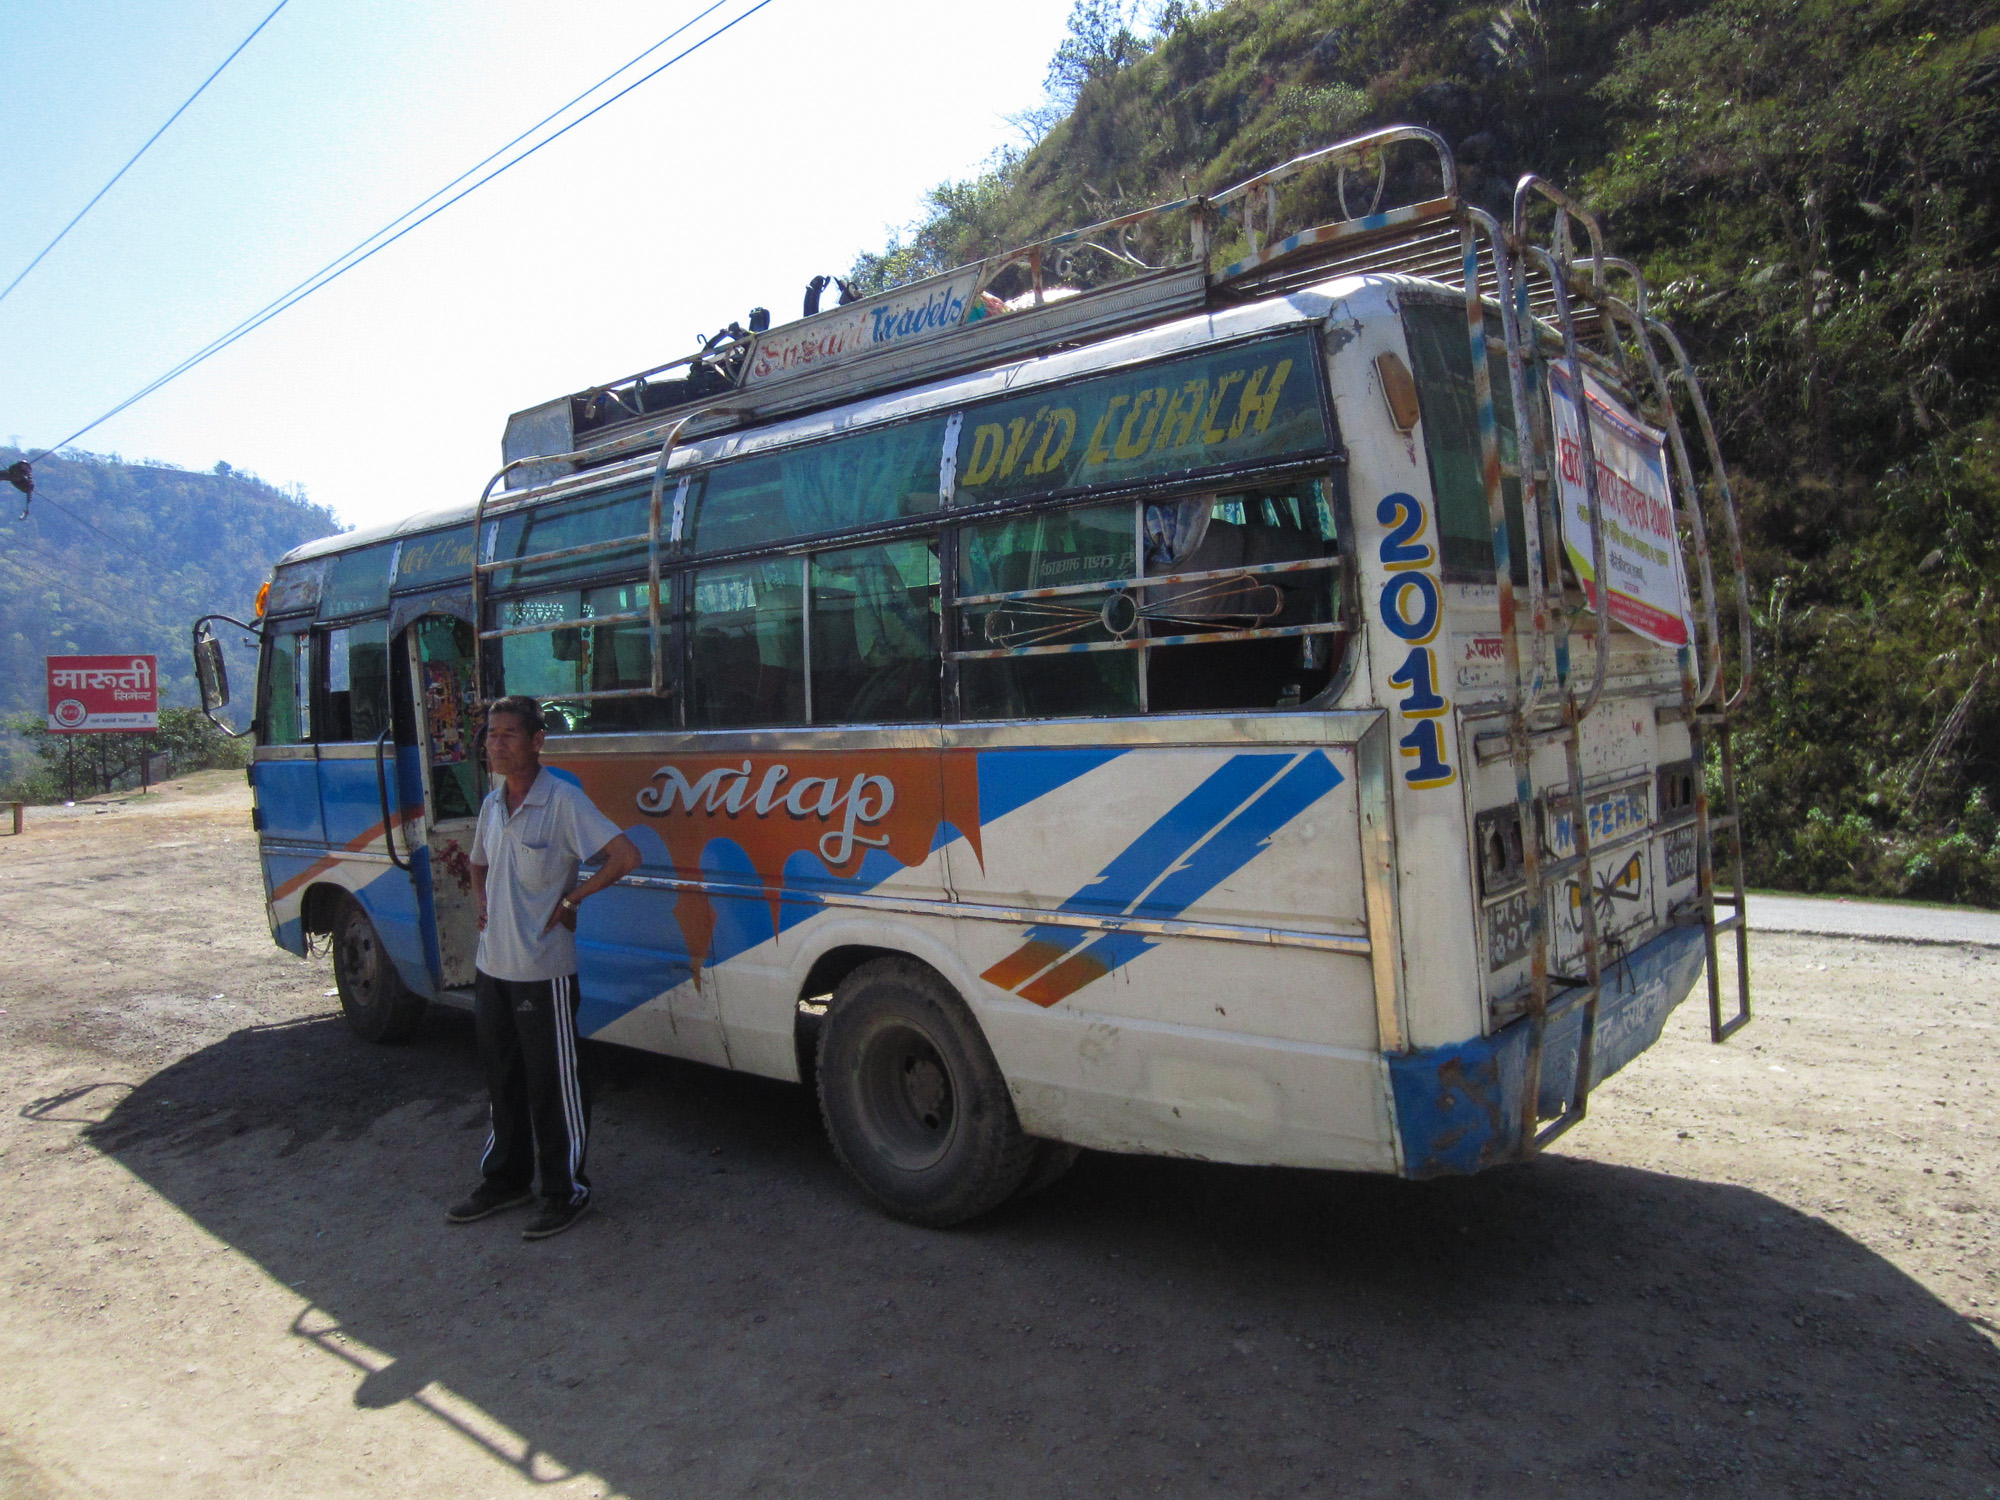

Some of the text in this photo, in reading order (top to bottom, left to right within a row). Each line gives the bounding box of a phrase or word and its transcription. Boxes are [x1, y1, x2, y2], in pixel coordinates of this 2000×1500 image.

[870, 286, 968, 343] Travels
[962, 358, 1294, 486] DVD COACH
[52, 659, 151, 690] मारूती
[1376, 492, 1458, 790] 2011
[636, 759, 895, 864] Milap
[1588, 797, 1644, 840] FEAR
